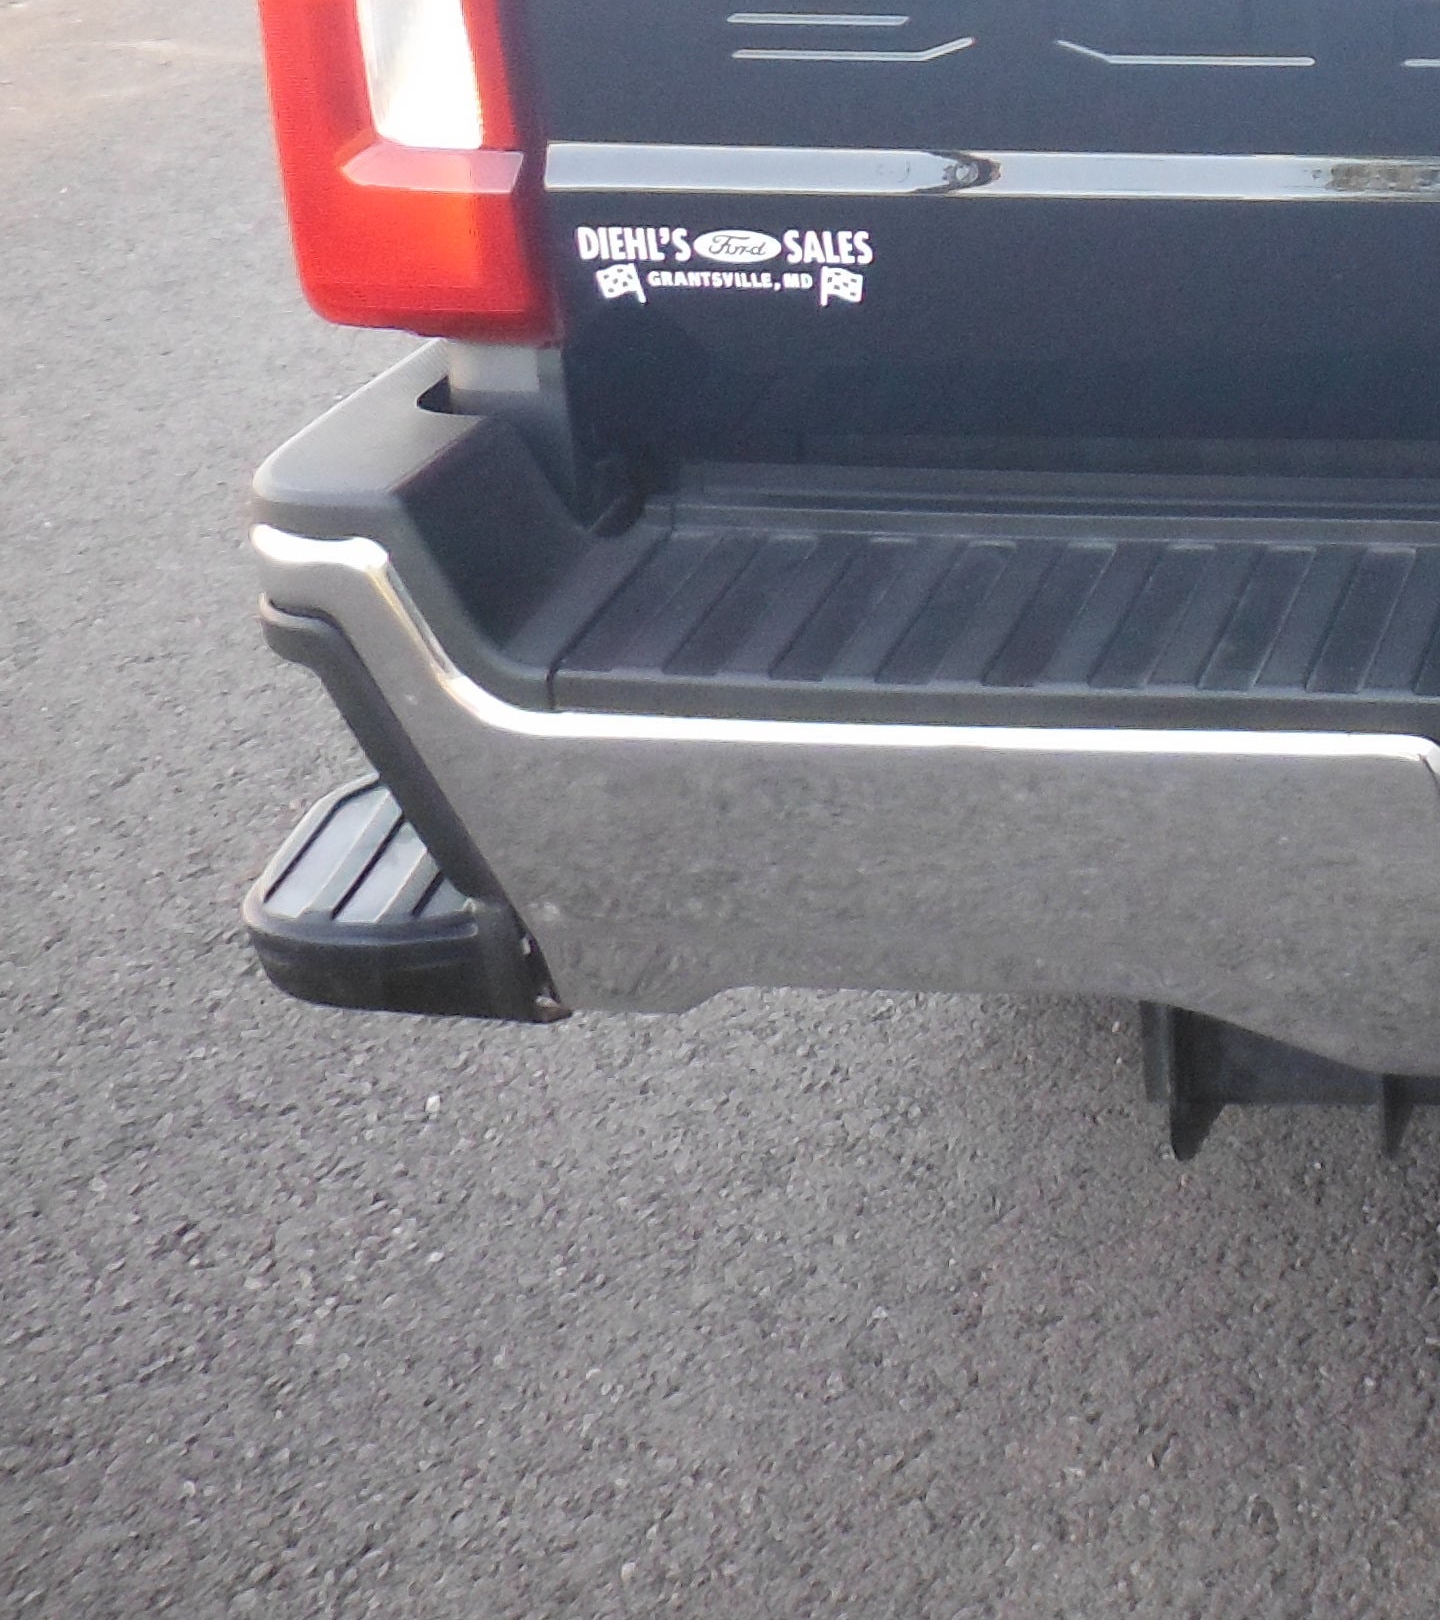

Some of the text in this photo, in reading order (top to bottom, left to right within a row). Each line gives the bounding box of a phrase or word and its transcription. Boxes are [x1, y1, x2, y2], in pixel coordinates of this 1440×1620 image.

[577, 226, 874, 264] DIEHL'S Ford SALES
[783, 272, 814, 289] MD
